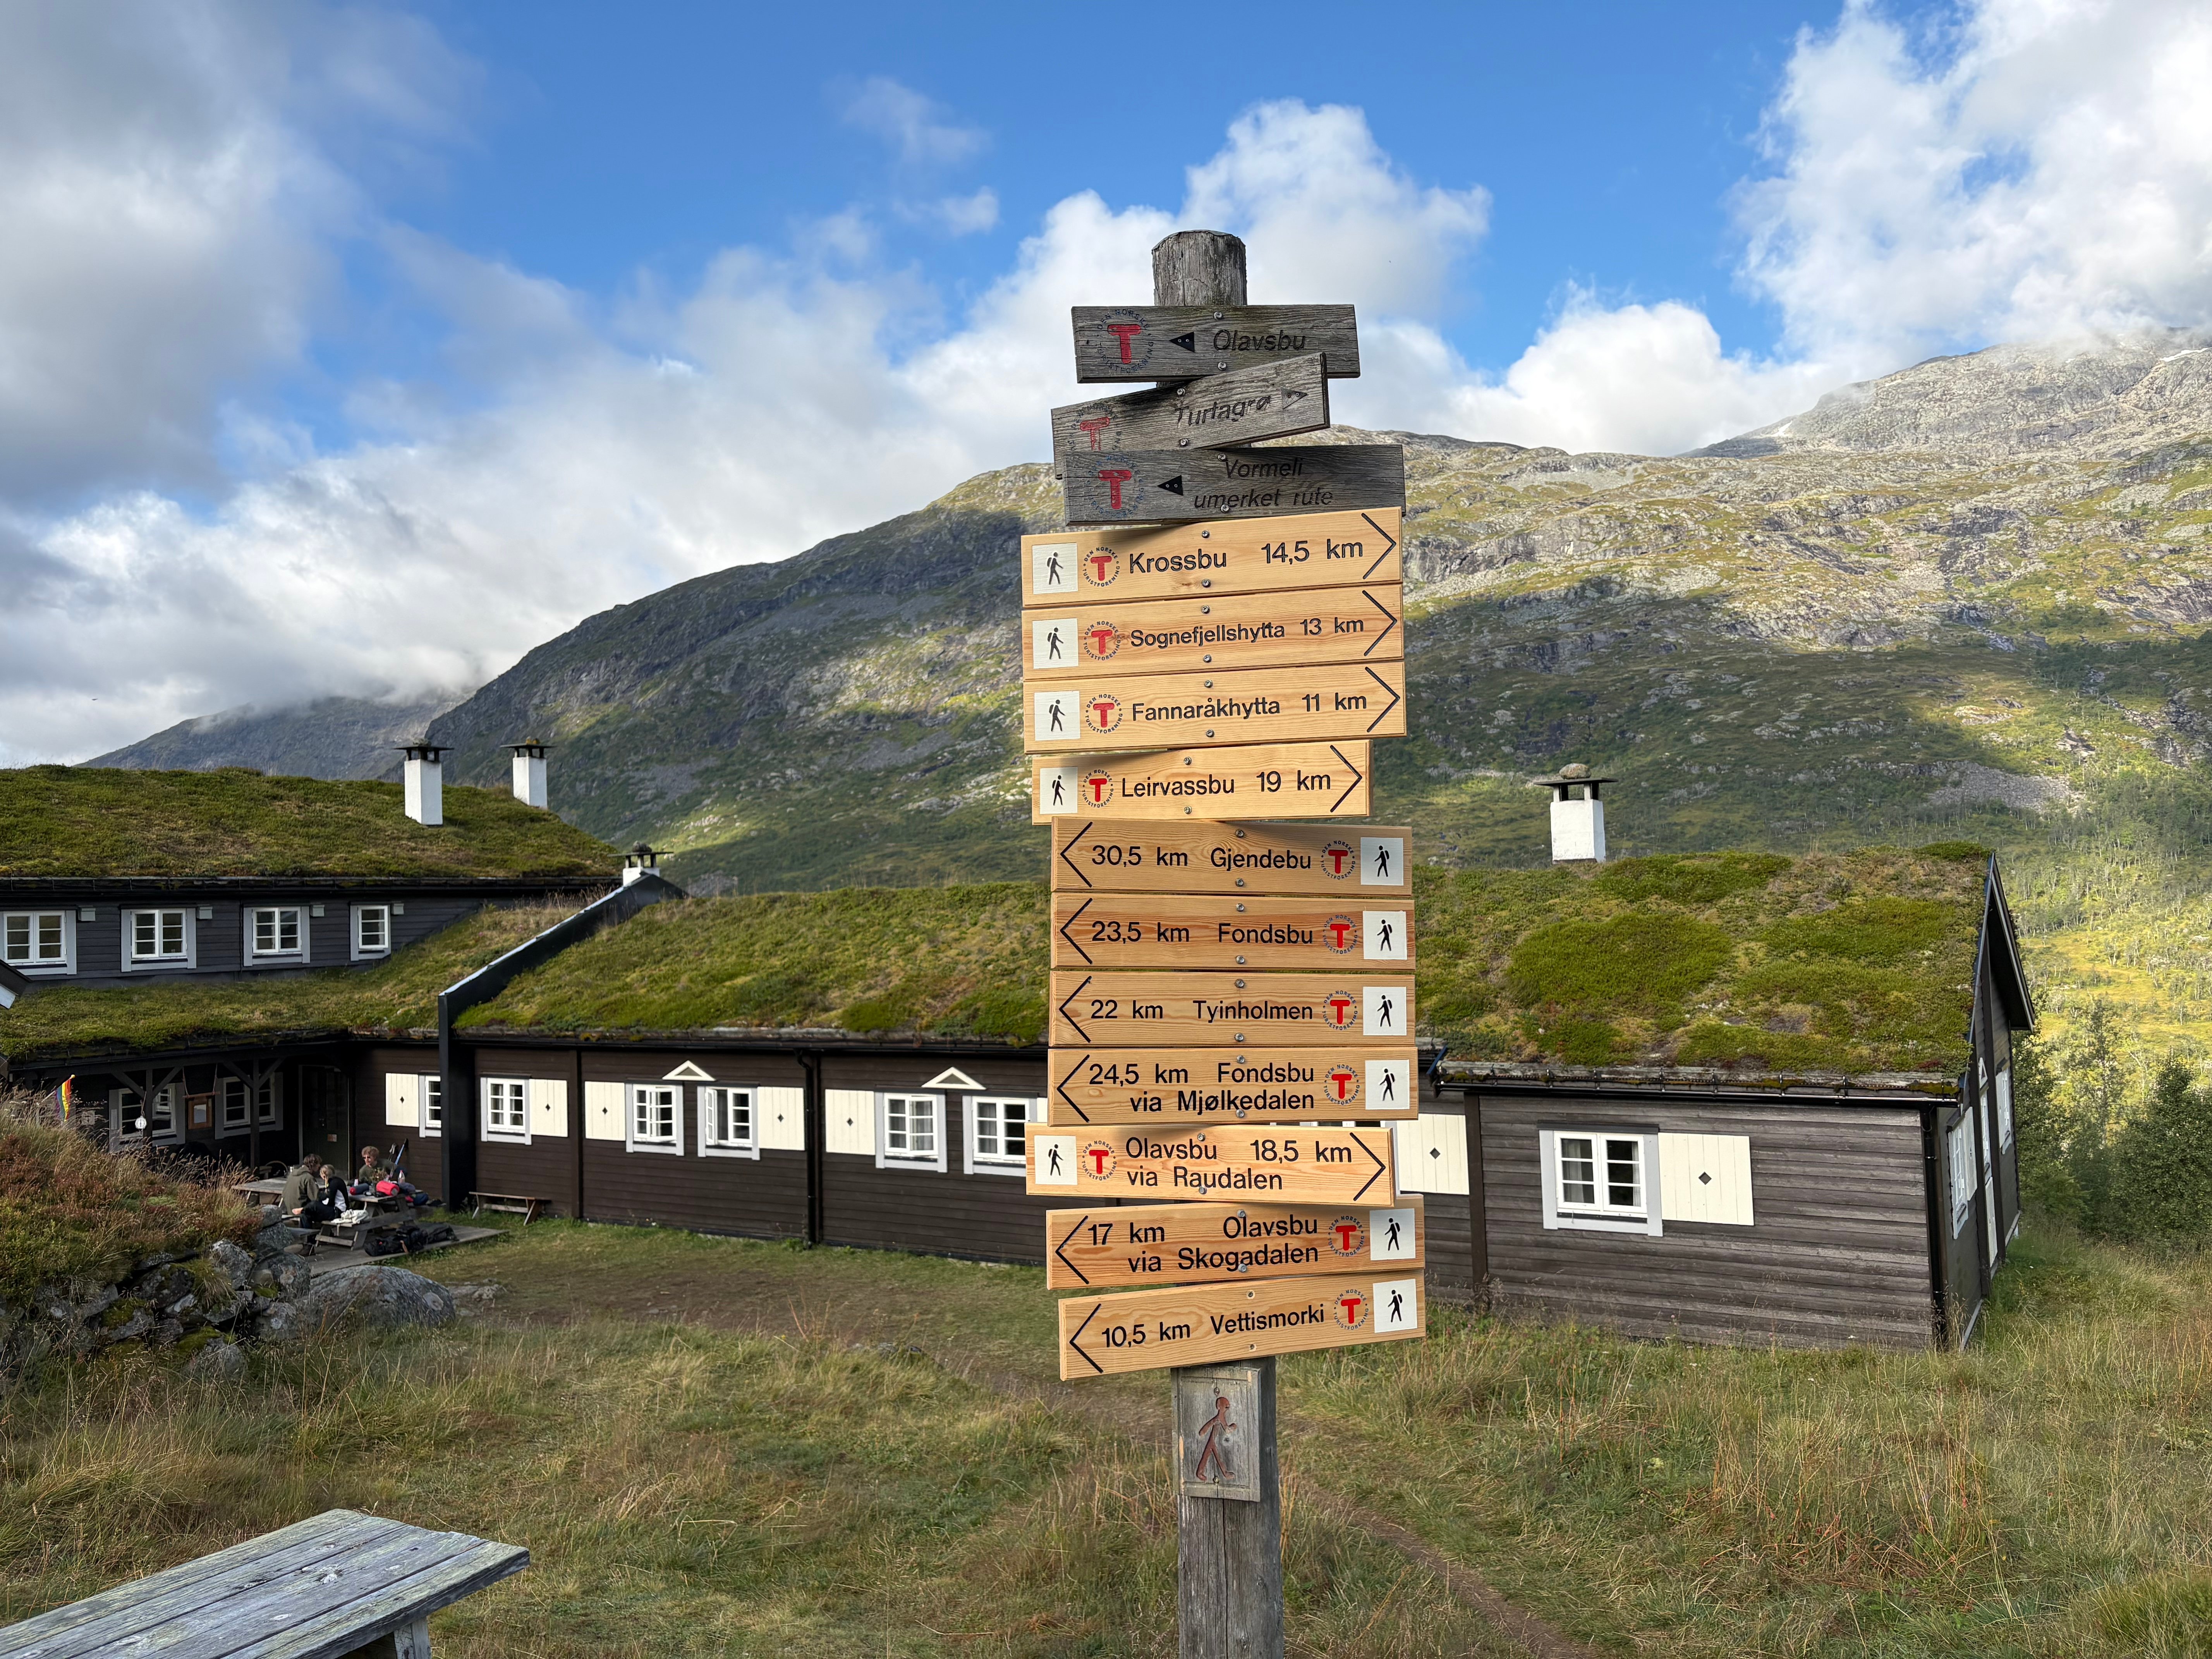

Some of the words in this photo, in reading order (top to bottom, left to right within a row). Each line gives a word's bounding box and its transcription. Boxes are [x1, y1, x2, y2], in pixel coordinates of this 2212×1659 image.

[1108, 324, 1141, 363] T
[1213, 329, 1305, 350] Olavsbu
[1175, 395, 1271, 427] Turtagrø
[1224, 457, 1303, 478] Vormeli
[1098, 470, 1132, 509] T
[1194, 488, 1281, 509] umerket
[1293, 487, 1333, 506] rute
[1084, 551, 1094, 562] DEN
[1091, 556, 1112, 581] T
[1129, 548, 1227, 574] Krossbu
[1261, 540, 1310, 565] 14,5
[1326, 538, 1363, 560] km
[1085, 624, 1094, 635] DEN
[1091, 630, 1112, 654] T
[1130, 622, 1285, 649] Sognefjellshytta
[1299, 618, 1322, 636] 13
[1334, 617, 1364, 634] km
[1087, 697, 1096, 708] DEN
[1132, 697, 1280, 721] Fannaråkhytta
[1301, 693, 1320, 712] 11
[1334, 692, 1367, 711] km
[1093, 703, 1115, 728] T
[1083, 773, 1092, 783] DEN
[1089, 778, 1107, 802] T
[1122, 774, 1235, 797] Leirvassbu
[1256, 770, 1281, 793] 19
[1297, 769, 1331, 791] km
[1092, 845, 1142, 868] 30,5
[1156, 846, 1188, 867] km
[1210, 847, 1311, 872] Gjendebu
[1322, 843, 1331, 853] DEN
[1328, 850, 1348, 874] T
[1092, 920, 1142, 945] 23,5
[1157, 921, 1190, 943] km
[1218, 922, 1313, 945] Fondsbu
[1330, 924, 1350, 948] T
[1324, 993, 1333, 1004] DEN
[1091, 999, 1118, 1019] 22
[1132, 1000, 1163, 1019] km
[1192, 1000, 1313, 1024] Tyinholmen
[1330, 1000, 1350, 1024] T
[1089, 1063, 1140, 1087] 24,5
[1155, 1063, 1188, 1084] km
[1218, 1061, 1314, 1083] Fondsbu
[1325, 1067, 1334, 1078] DEN
[1331, 1074, 1352, 1099] T
[1130, 1092, 1162, 1112] via
[1177, 1090, 1314, 1115] Mjølkedalen
[1083, 1143, 1092, 1154] DEN
[1125, 1136, 1218, 1160] Olavsbu
[1250, 1139, 1299, 1164] 18,5
[1315, 1140, 1353, 1163] km
[1089, 1150, 1109, 1174] T
[1126, 1167, 1158, 1187] via
[1173, 1166, 1283, 1190] Raudalen
[1087, 1221, 1113, 1247] 17
[1130, 1222, 1165, 1244] km
[1222, 1215, 1318, 1239] Olavsbu
[1336, 1225, 1357, 1250] T
[1127, 1250, 1162, 1273] via
[1177, 1242, 1319, 1273] Skogadalen
[1335, 1293, 1344, 1305] DEN
[1341, 1298, 1361, 1324] T
[1101, 1323, 1146, 1348] 10,5
[1159, 1321, 1190, 1341] km
[1210, 1303, 1324, 1335] Vettismorki
